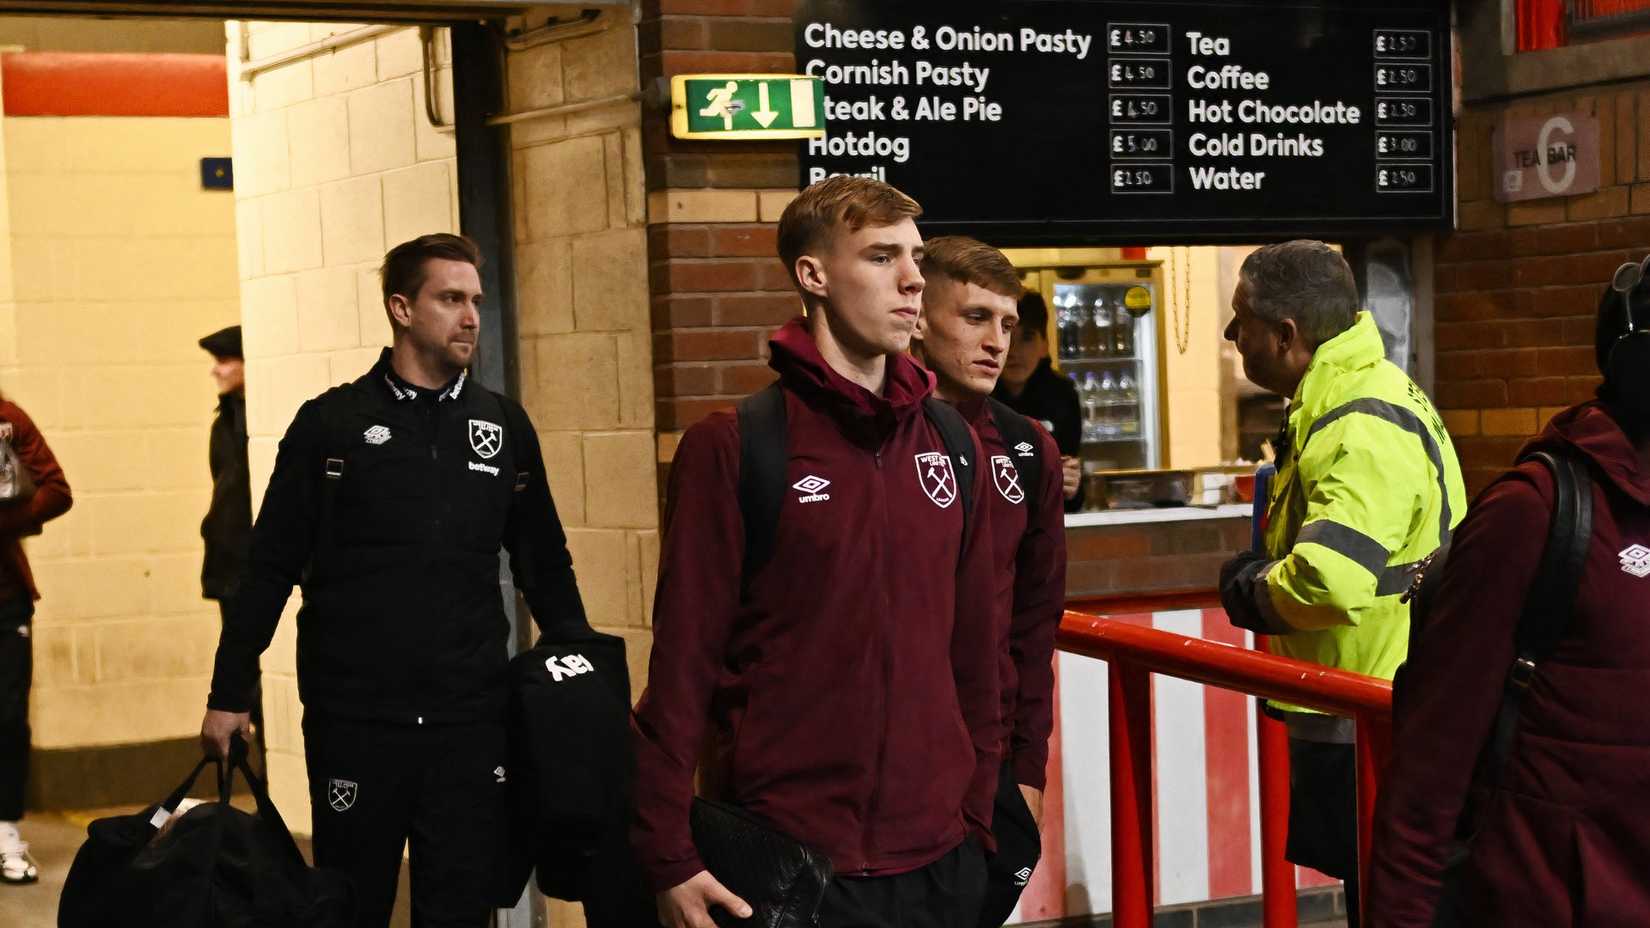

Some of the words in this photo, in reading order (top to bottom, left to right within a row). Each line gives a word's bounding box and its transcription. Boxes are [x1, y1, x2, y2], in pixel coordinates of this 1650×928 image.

[805, 23, 905, 49] Cheese
[911, 26, 930, 50] &
[936, 26, 1014, 51] Onion
[1020, 28, 1092, 59] Pasty
[1186, 32, 1230, 55] Tea
[806, 59, 909, 85] Cornish
[916, 61, 989, 92] Pasty
[1187, 65, 1269, 89] Coffee
[824, 96, 885, 121] teak
[891, 96, 909, 121] &
[915, 96, 956, 121] Ale
[963, 96, 1002, 121] Pie
[1189, 100, 1233, 123] Hot
[1238, 100, 1360, 124] Chocolate
[809, 131, 910, 162] Hotdog
[1189, 133, 1243, 156] Cold
[1250, 133, 1324, 156] Drinks
[1513, 148, 1541, 168] TEA
[1548, 144, 1576, 164] BAR
[1189, 167, 1265, 190] Water
[468, 461, 499, 476] betway
[799, 494, 830, 503] umbro
